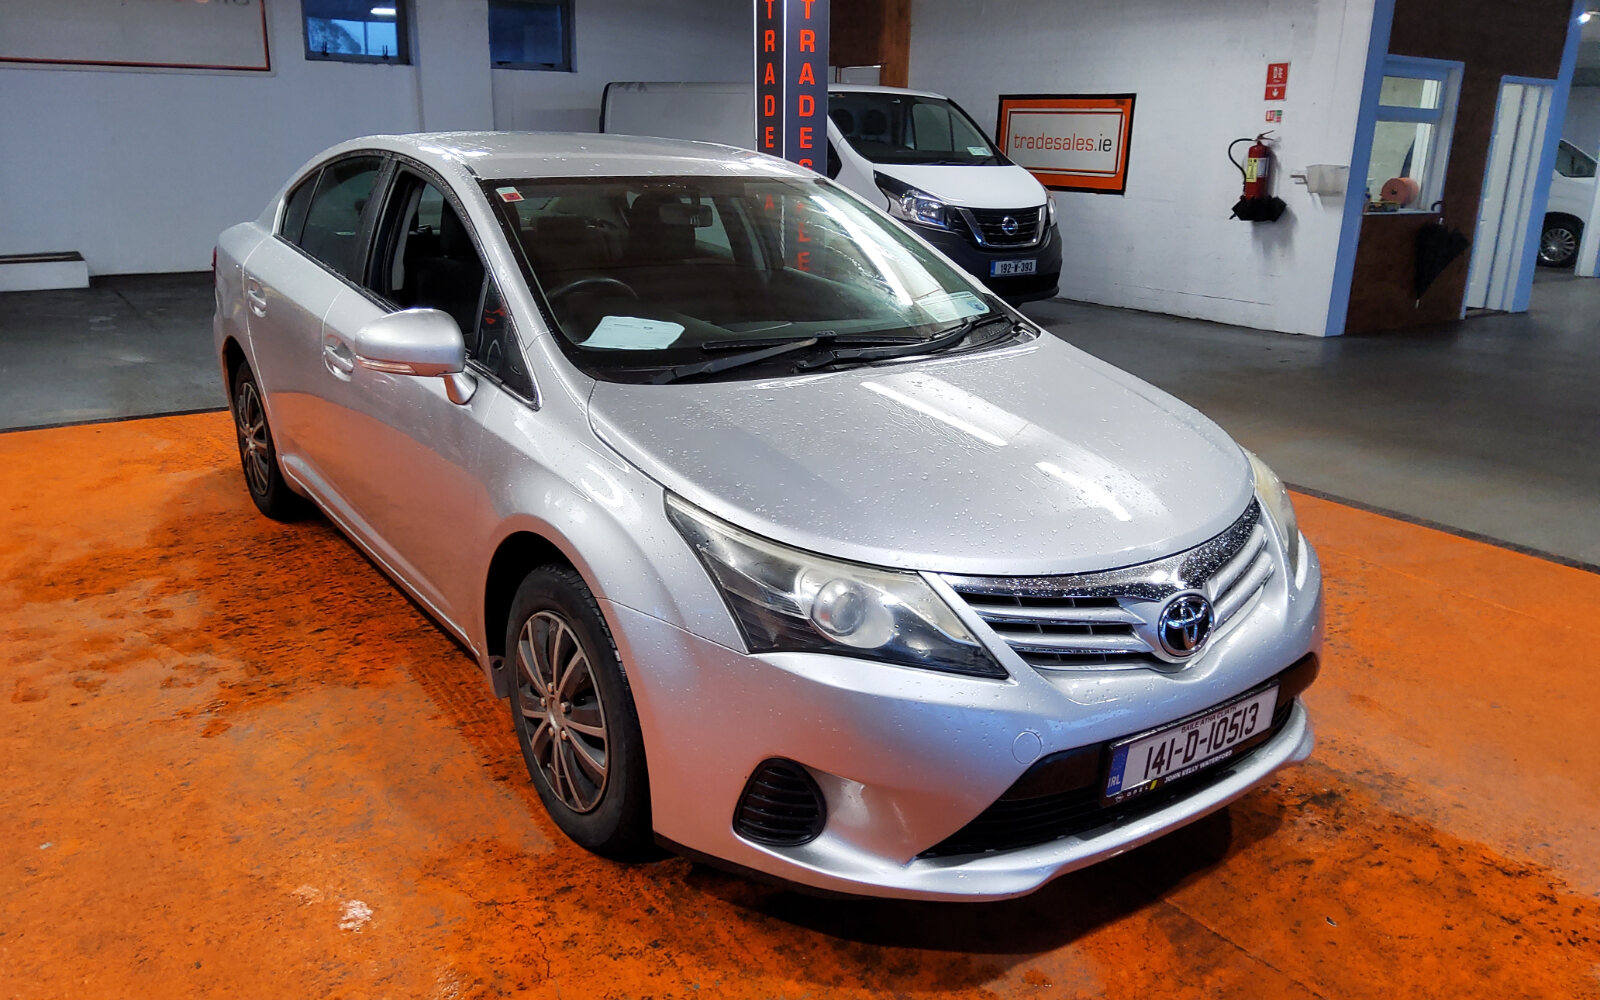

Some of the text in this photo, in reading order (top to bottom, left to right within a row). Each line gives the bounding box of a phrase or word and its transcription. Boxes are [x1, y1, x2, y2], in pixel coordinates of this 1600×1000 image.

[764, 0, 775, 148] TRADE
[1014, 132, 1112, 152] tradesales.ie
[1144, 702, 1259, 780] 141-D-10513
[1107, 774, 1121, 789] IRL
[1164, 750, 1232, 783] JOHN KELLY WATERFORD
